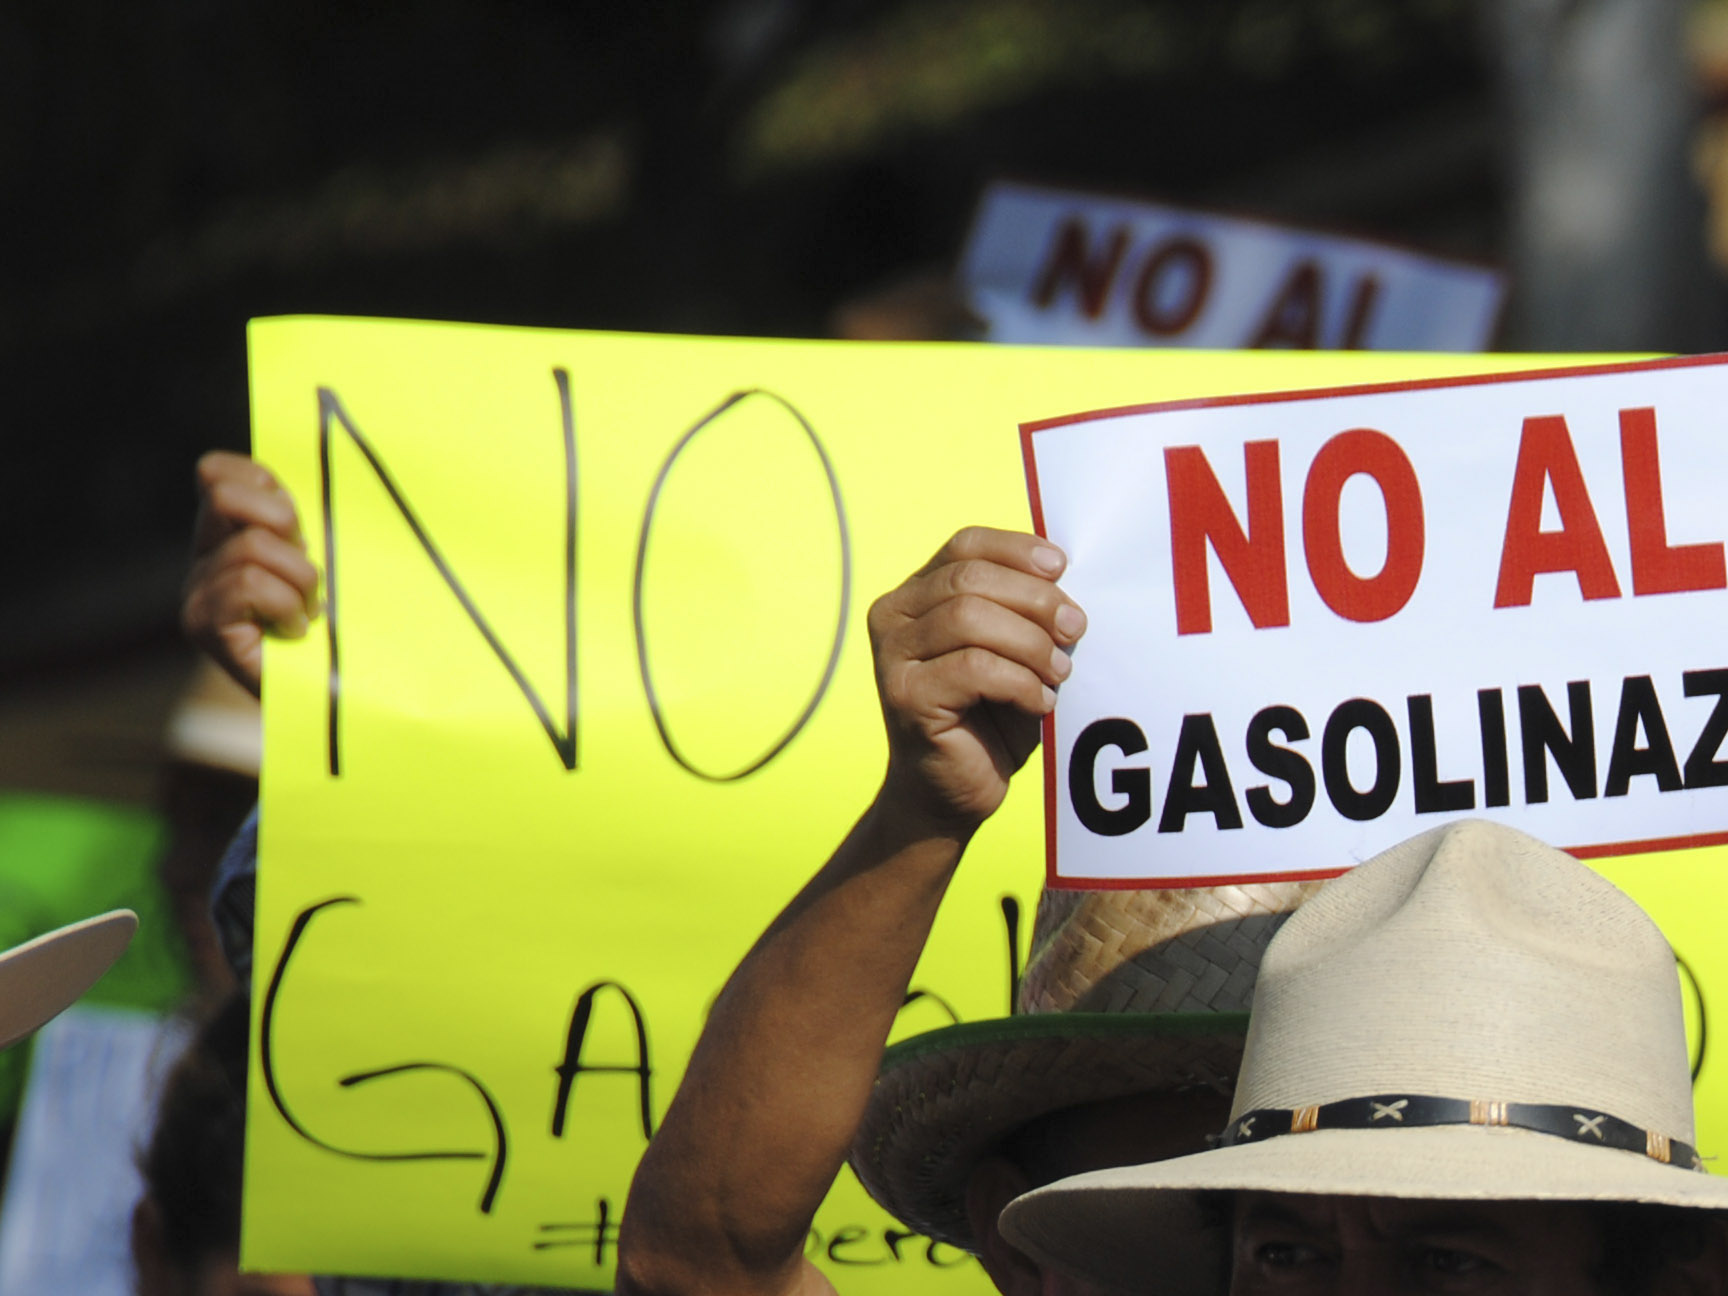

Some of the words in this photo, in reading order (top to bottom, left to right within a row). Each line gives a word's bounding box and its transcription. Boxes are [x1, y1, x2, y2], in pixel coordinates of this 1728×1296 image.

[1024, 214, 1217, 340] NO
[316, 366, 852, 784] NO
[1166, 428, 1425, 635] NO
[1496, 408, 1727, 608] AL
